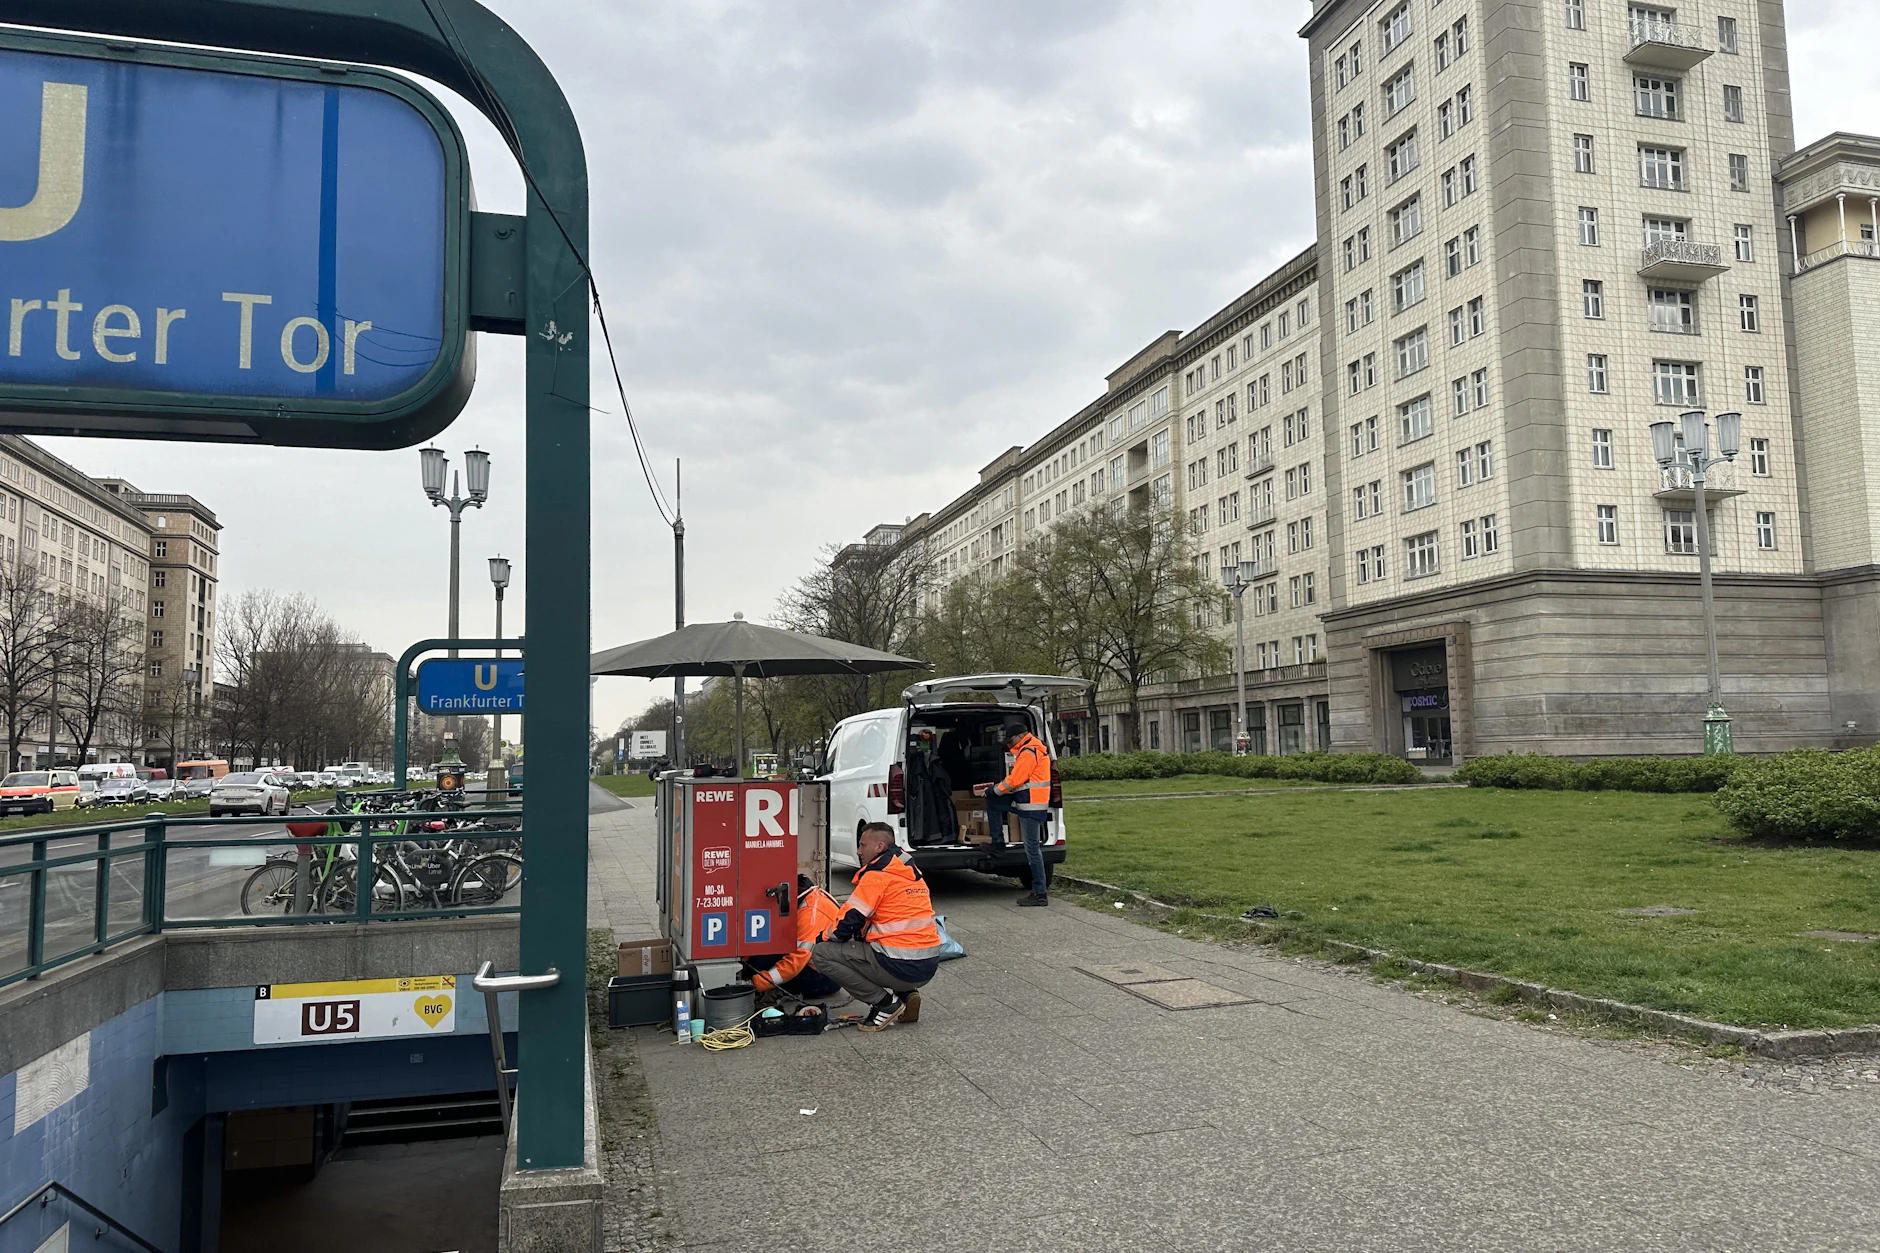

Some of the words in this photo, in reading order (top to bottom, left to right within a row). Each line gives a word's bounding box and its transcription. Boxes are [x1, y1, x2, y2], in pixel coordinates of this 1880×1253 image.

[9, 288, 187, 365] rter
[222, 292, 373, 375] Tor
[475, 664, 498, 691] U
[430, 694, 512, 709] Frankfurter
[1409, 694, 1437, 707] COSMIC
[696, 790, 734, 803] REWE
[704, 850, 730, 859] REWE
[705, 884, 725, 896] MO-SA
[721, 896, 734, 907] UHR
[707, 918, 722, 941] P
[751, 915, 766, 938] P
[259, 987, 267, 998] B
[424, 1004, 443, 1015] BVG
[308, 1003, 354, 1032] U5
